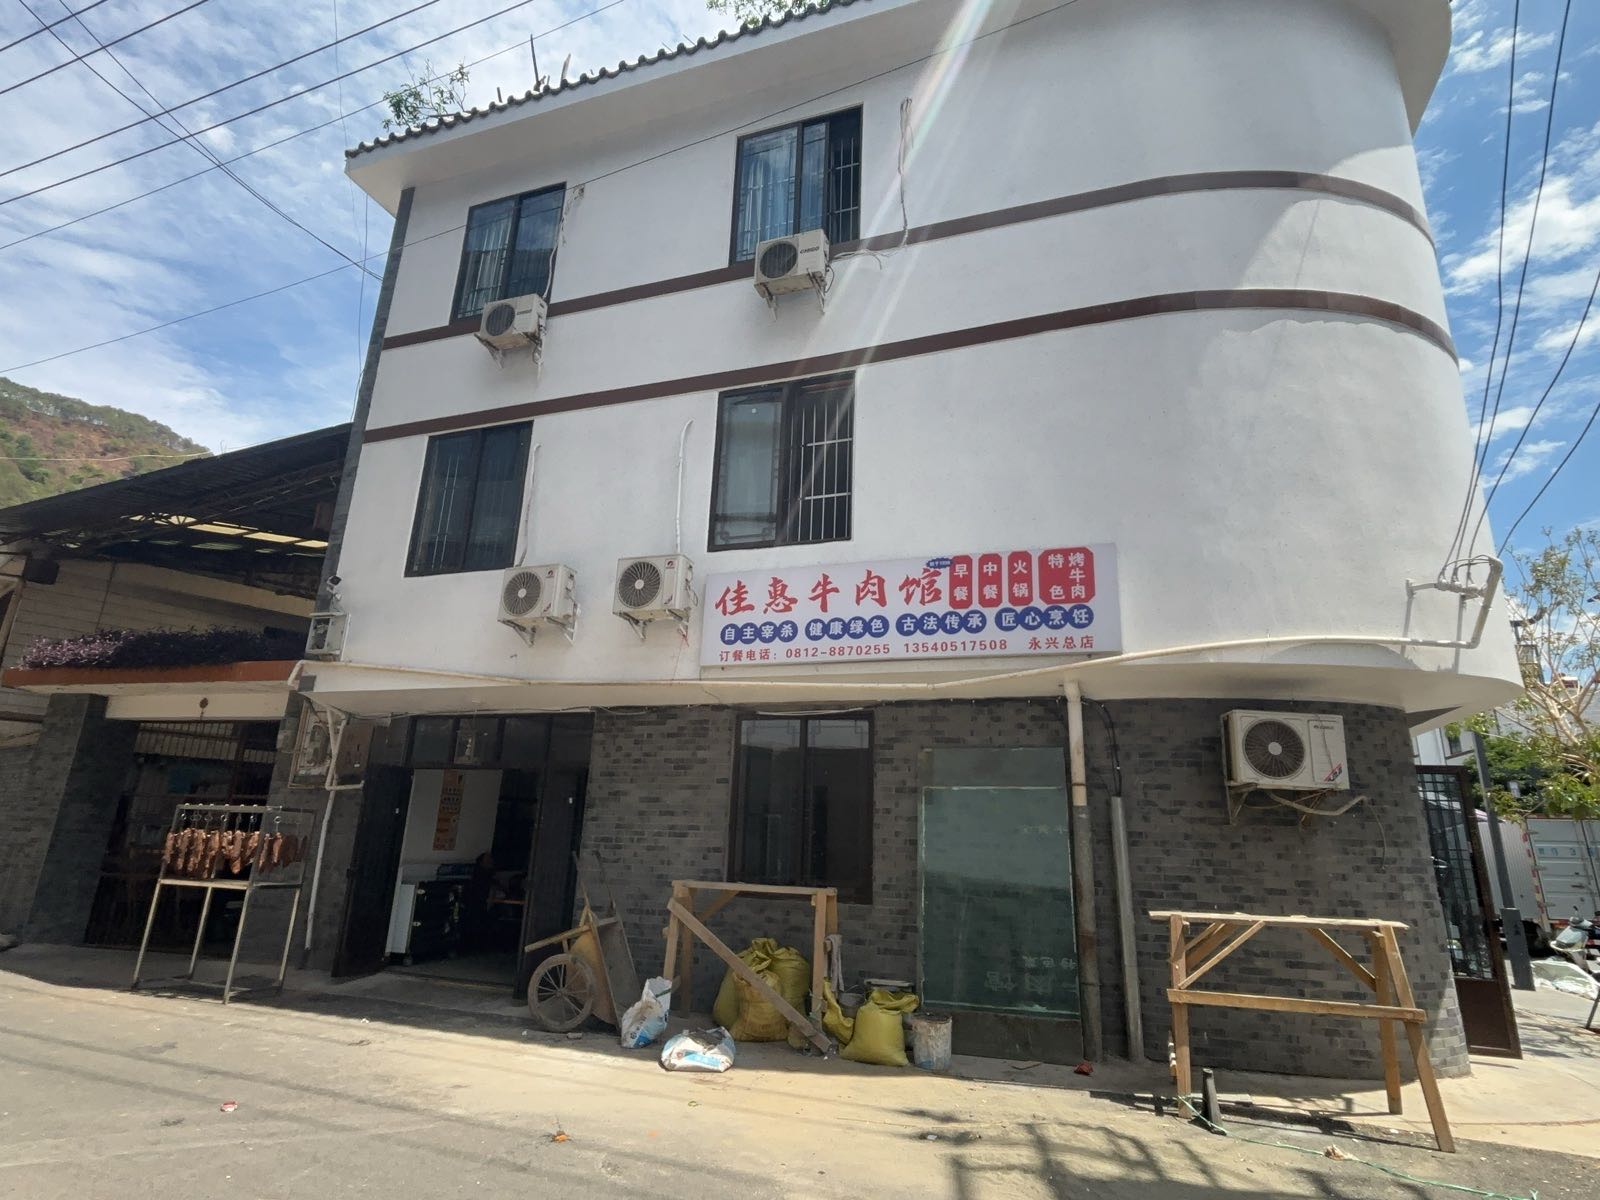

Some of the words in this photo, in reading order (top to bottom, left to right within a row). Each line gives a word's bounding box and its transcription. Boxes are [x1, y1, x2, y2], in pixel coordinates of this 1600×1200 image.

[715, 568, 942, 616] 佳惠牛肉馆
[953, 563, 969, 601] 早餐
[983, 562, 999, 600] 中餐
[1013, 560, 1029, 598] 火锅
[1048, 554, 1065, 600] 特色
[1068, 552, 1086, 599] 烤牛肉
[724, 624, 794, 641] 自主宰杀
[809, 618, 884, 637] 健康绿色
[901, 613, 982, 631] 古法传承
[1001, 608, 1089, 627] 匠心烹饪
[719, 648, 777, 662] 订餐电话：
[785, 644, 891, 659] 0812-8870255
[903, 639, 1008, 653] 13540517508
[1028, 635, 1095, 650] 永兴总店
